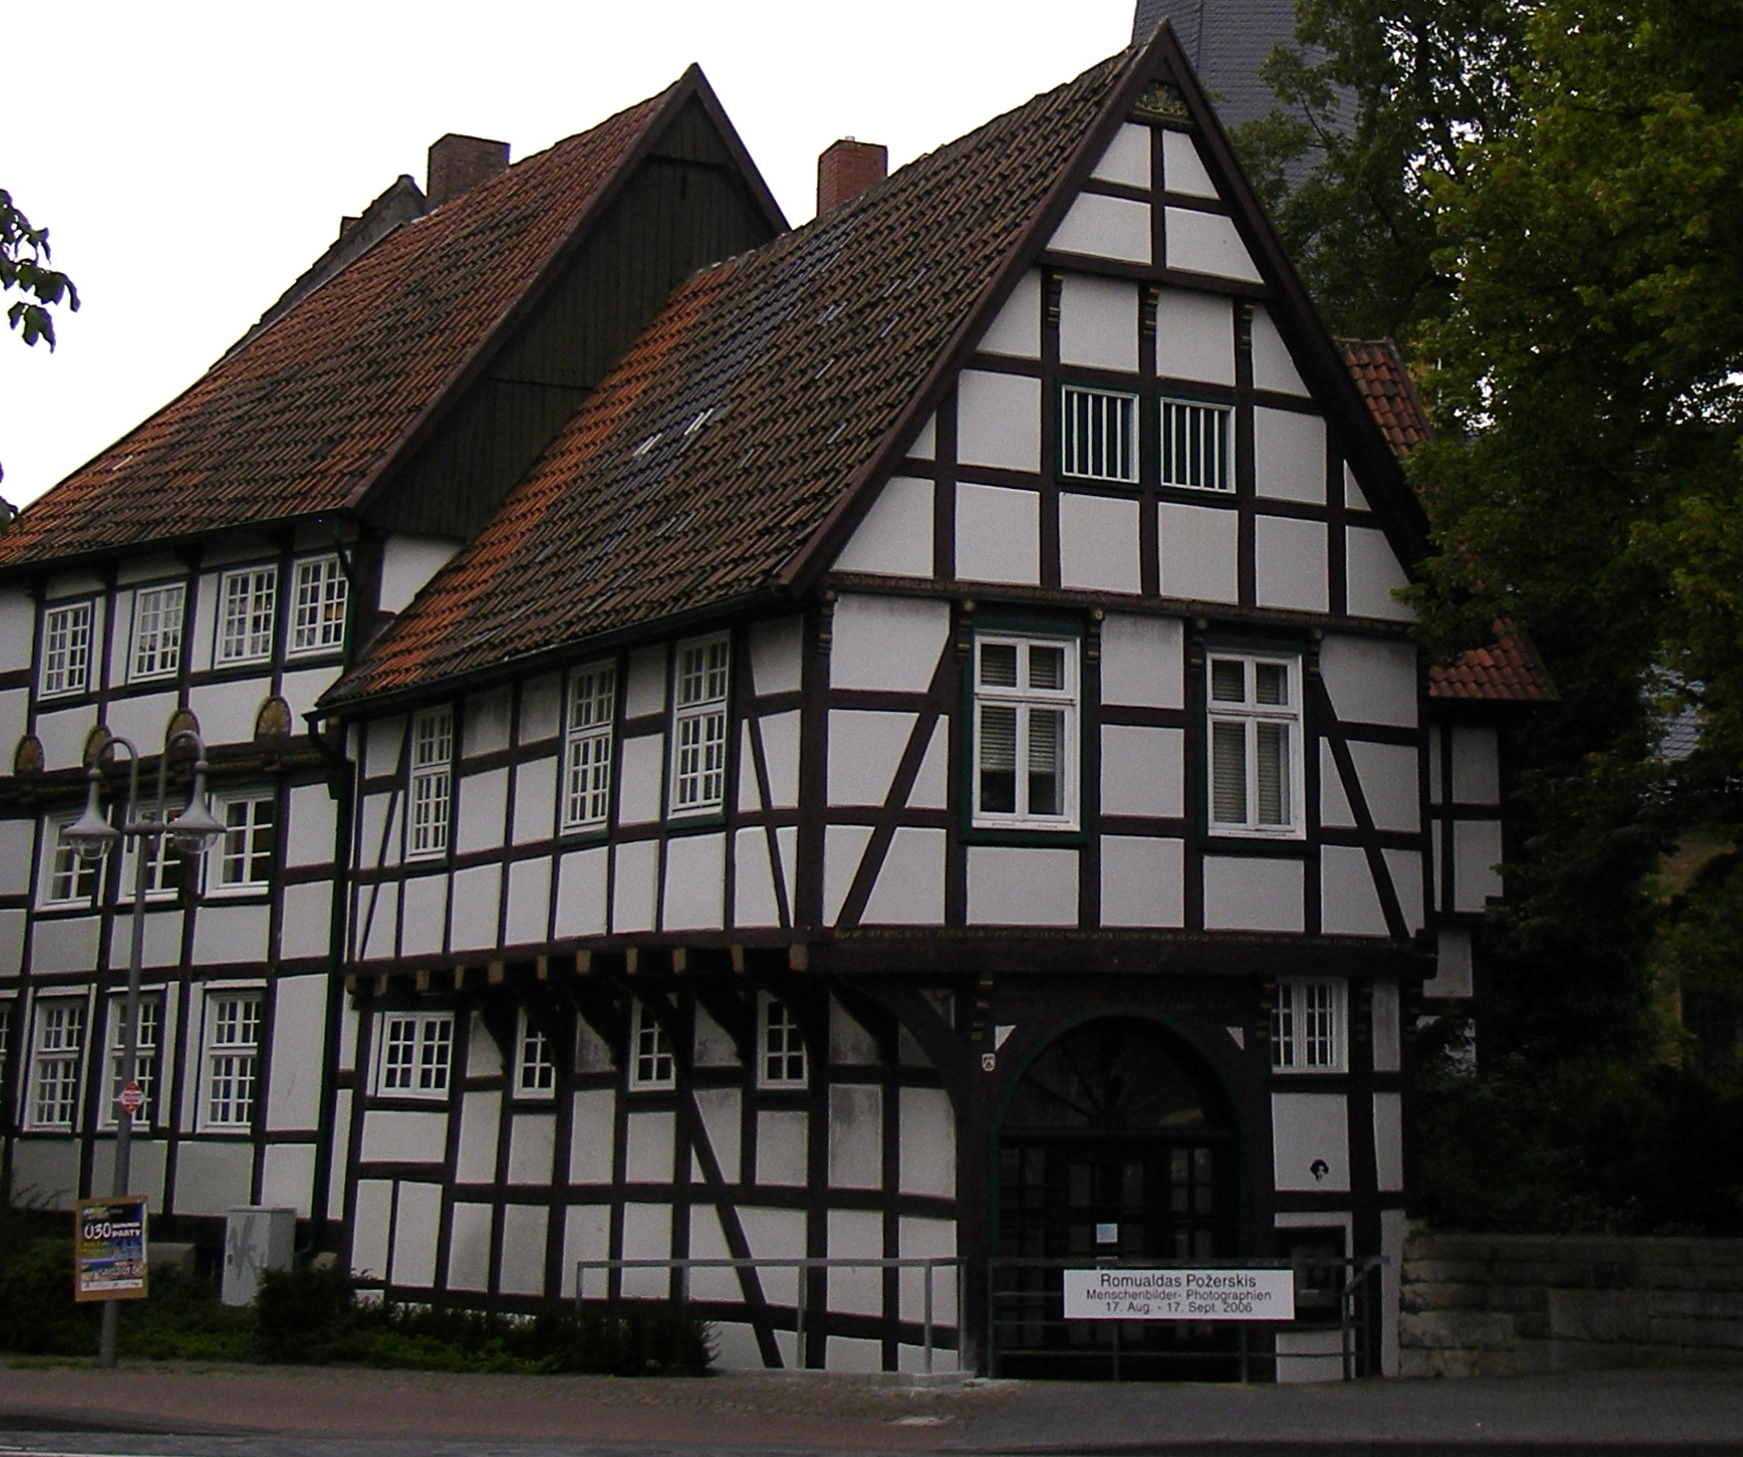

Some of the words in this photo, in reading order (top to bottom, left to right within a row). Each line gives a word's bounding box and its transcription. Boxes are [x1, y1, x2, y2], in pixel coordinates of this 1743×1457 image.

[112, 1229, 141, 1238] PARTY
[1100, 1273, 1181, 1288] Romualdas
[1186, 1273, 1256, 1288] Požerskis
[1086, 1289, 1182, 1300] Menschenbilder-
[1186, 1289, 1272, 1303] Photographien
[1106, 1302, 1123, 1313] 17.
[1127, 1302, 1153, 1315] Aug.
[1167, 1302, 1184, 1313] 17.
[1188, 1301, 1218, 1315] Sept.
[1223, 1301, 1253, 1313] 2006
